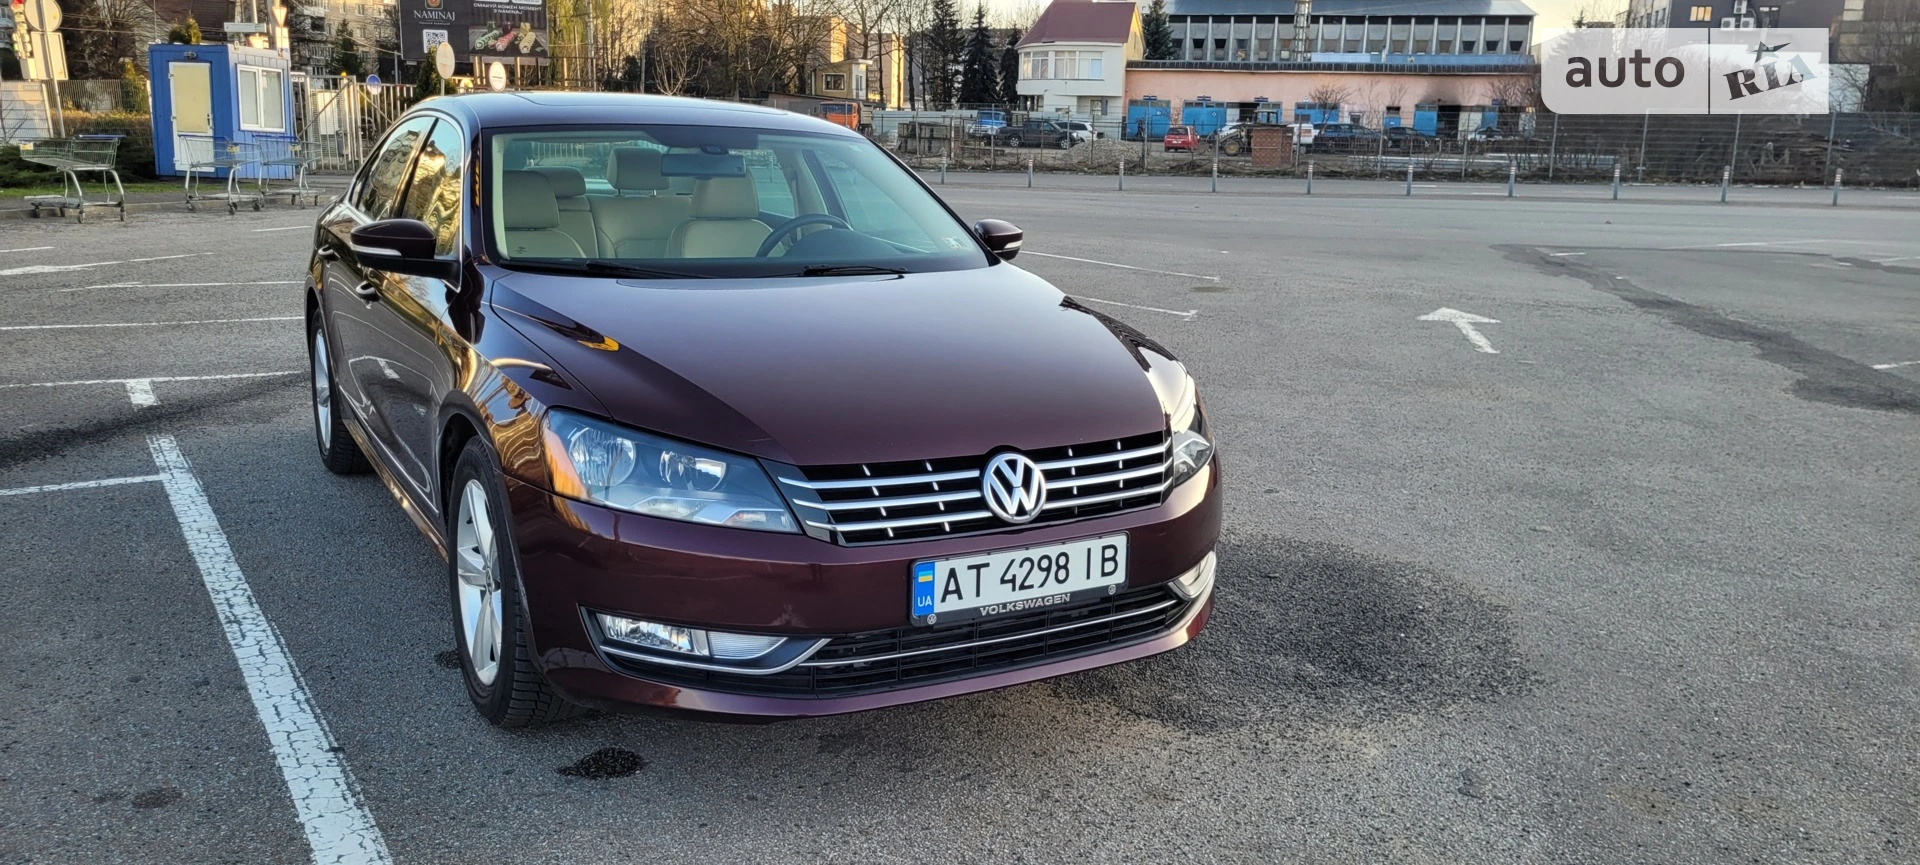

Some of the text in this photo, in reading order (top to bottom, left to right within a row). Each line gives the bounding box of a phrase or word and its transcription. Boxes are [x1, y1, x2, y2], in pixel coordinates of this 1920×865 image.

[413, 10, 455, 21] NAMINAJ
[940, 543, 1119, 603] AT 4298 IB
[917, 595, 933, 607] UA
[980, 593, 1071, 616] VOLKSWAGEN
